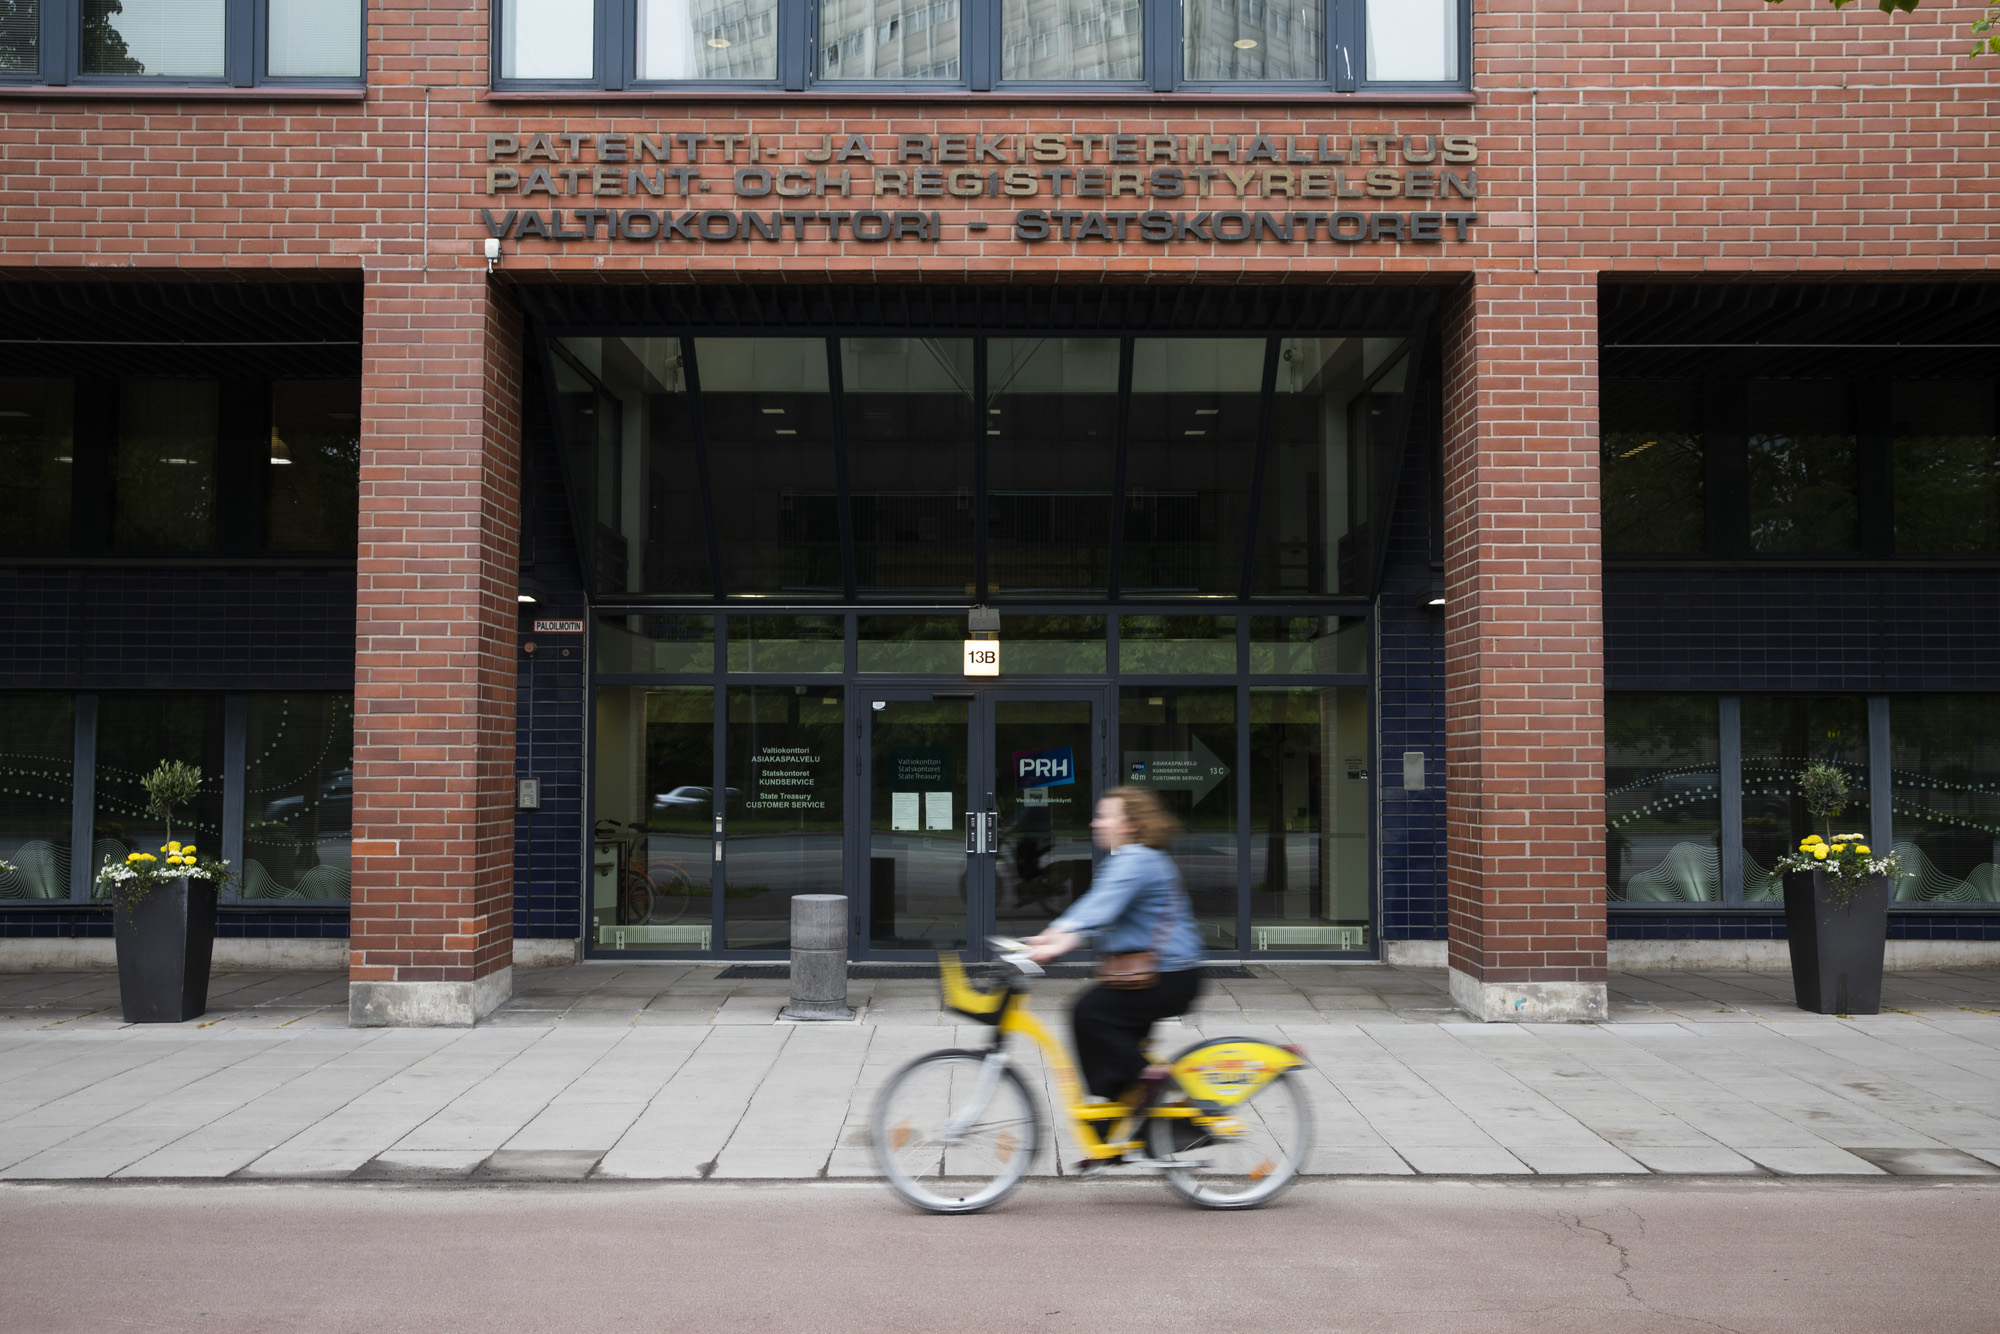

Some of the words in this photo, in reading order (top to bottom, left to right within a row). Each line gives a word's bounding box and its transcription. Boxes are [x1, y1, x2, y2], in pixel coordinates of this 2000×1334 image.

[486, 133, 778, 162] PATENTTI-
[804, 134, 874, 162] JA
[900, 134, 1478, 163] REKISTERIHALLITUS
[486, 167, 711, 196] PATENT-
[734, 168, 850, 197] OCH
[875, 168, 1478, 198] REGISTERSTYRELSEN
[481, 209, 940, 241] VALTIOKONTTORI
[1016, 210, 1478, 242] STATSKONTORET
[536, 622, 581, 631] PALOILMOITIN
[968, 650, 996, 664] 13B
[1019, 758, 1068, 777] PRH
[1210, 767, 1218, 775] 13
[1218, 767, 1224, 775] C
[780, 793, 811, 801] Treasury
